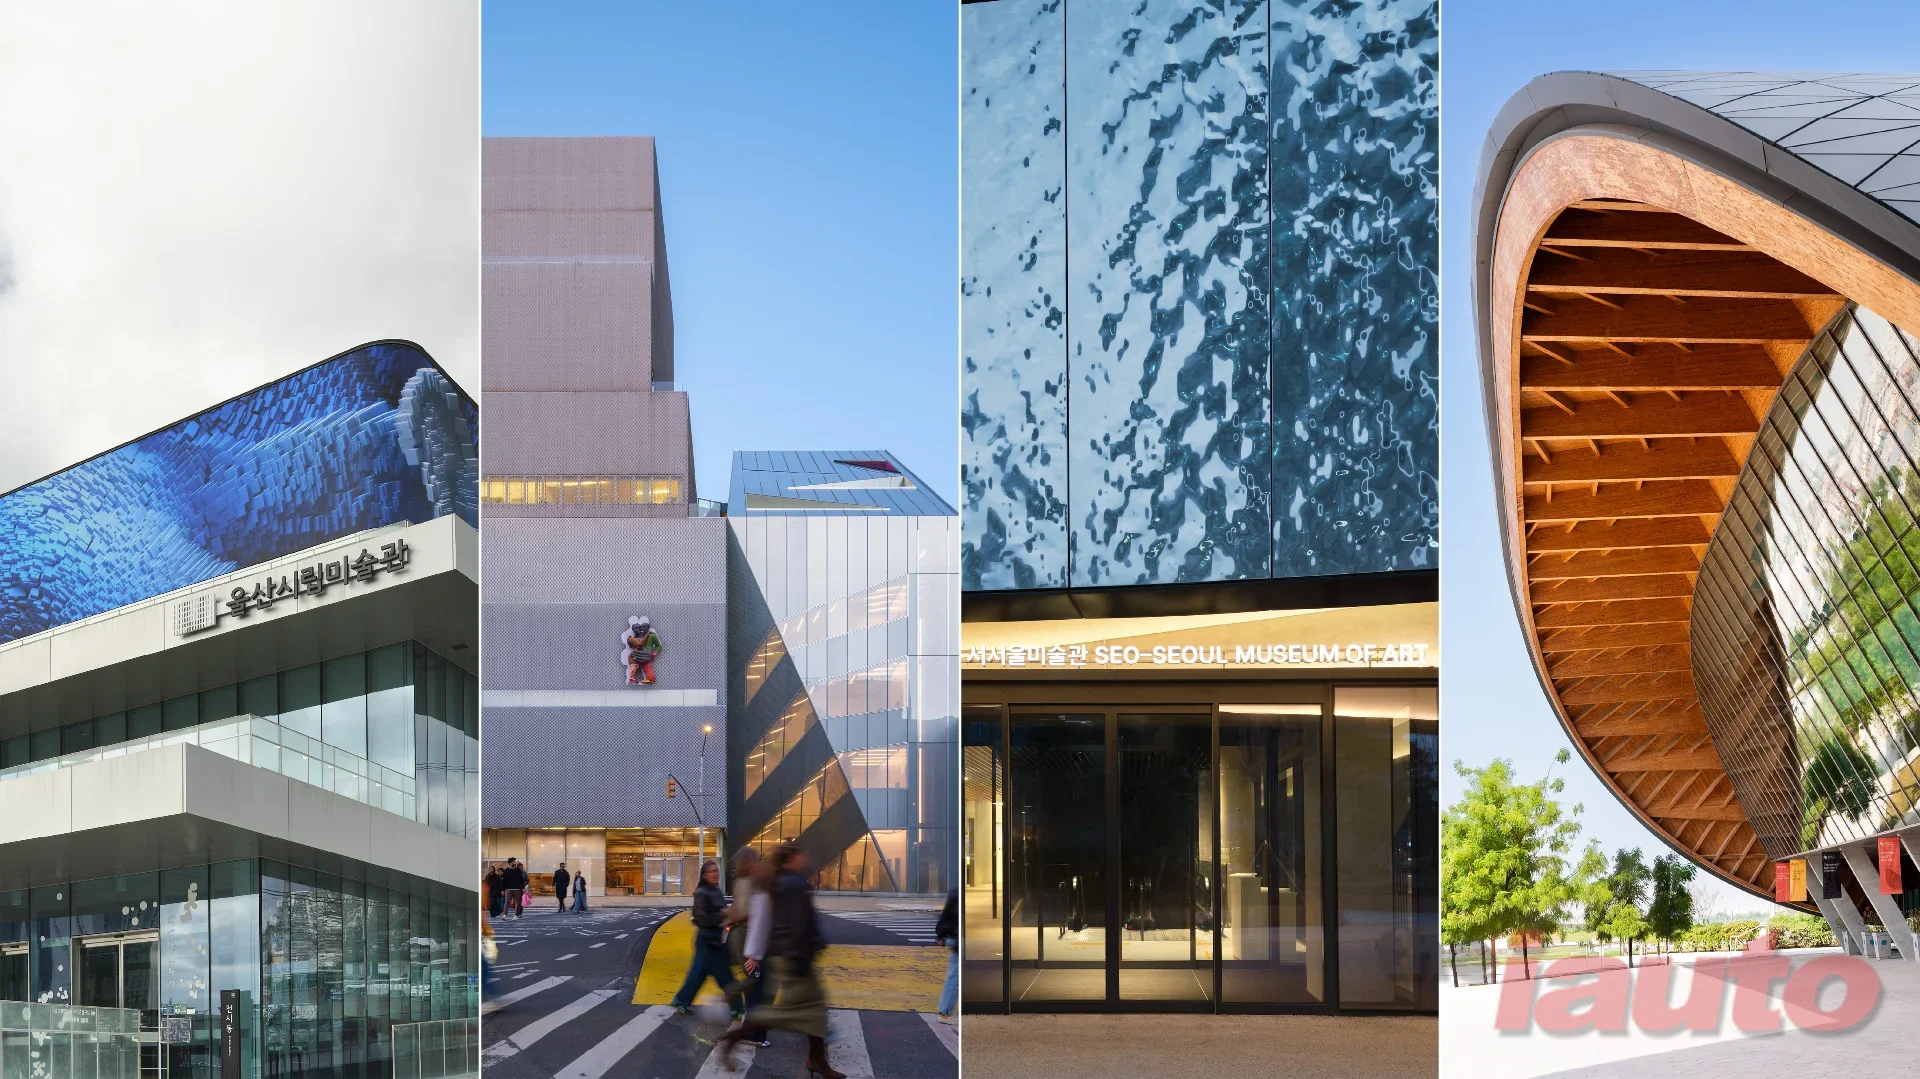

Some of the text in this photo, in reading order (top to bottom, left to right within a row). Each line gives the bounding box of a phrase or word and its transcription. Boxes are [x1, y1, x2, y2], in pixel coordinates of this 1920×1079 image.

[226, 539, 409, 617] 울산시립미술관
[967, 643, 1429, 666] 서서울미술관 SEO-SEOUL MUSEUM OF ART
